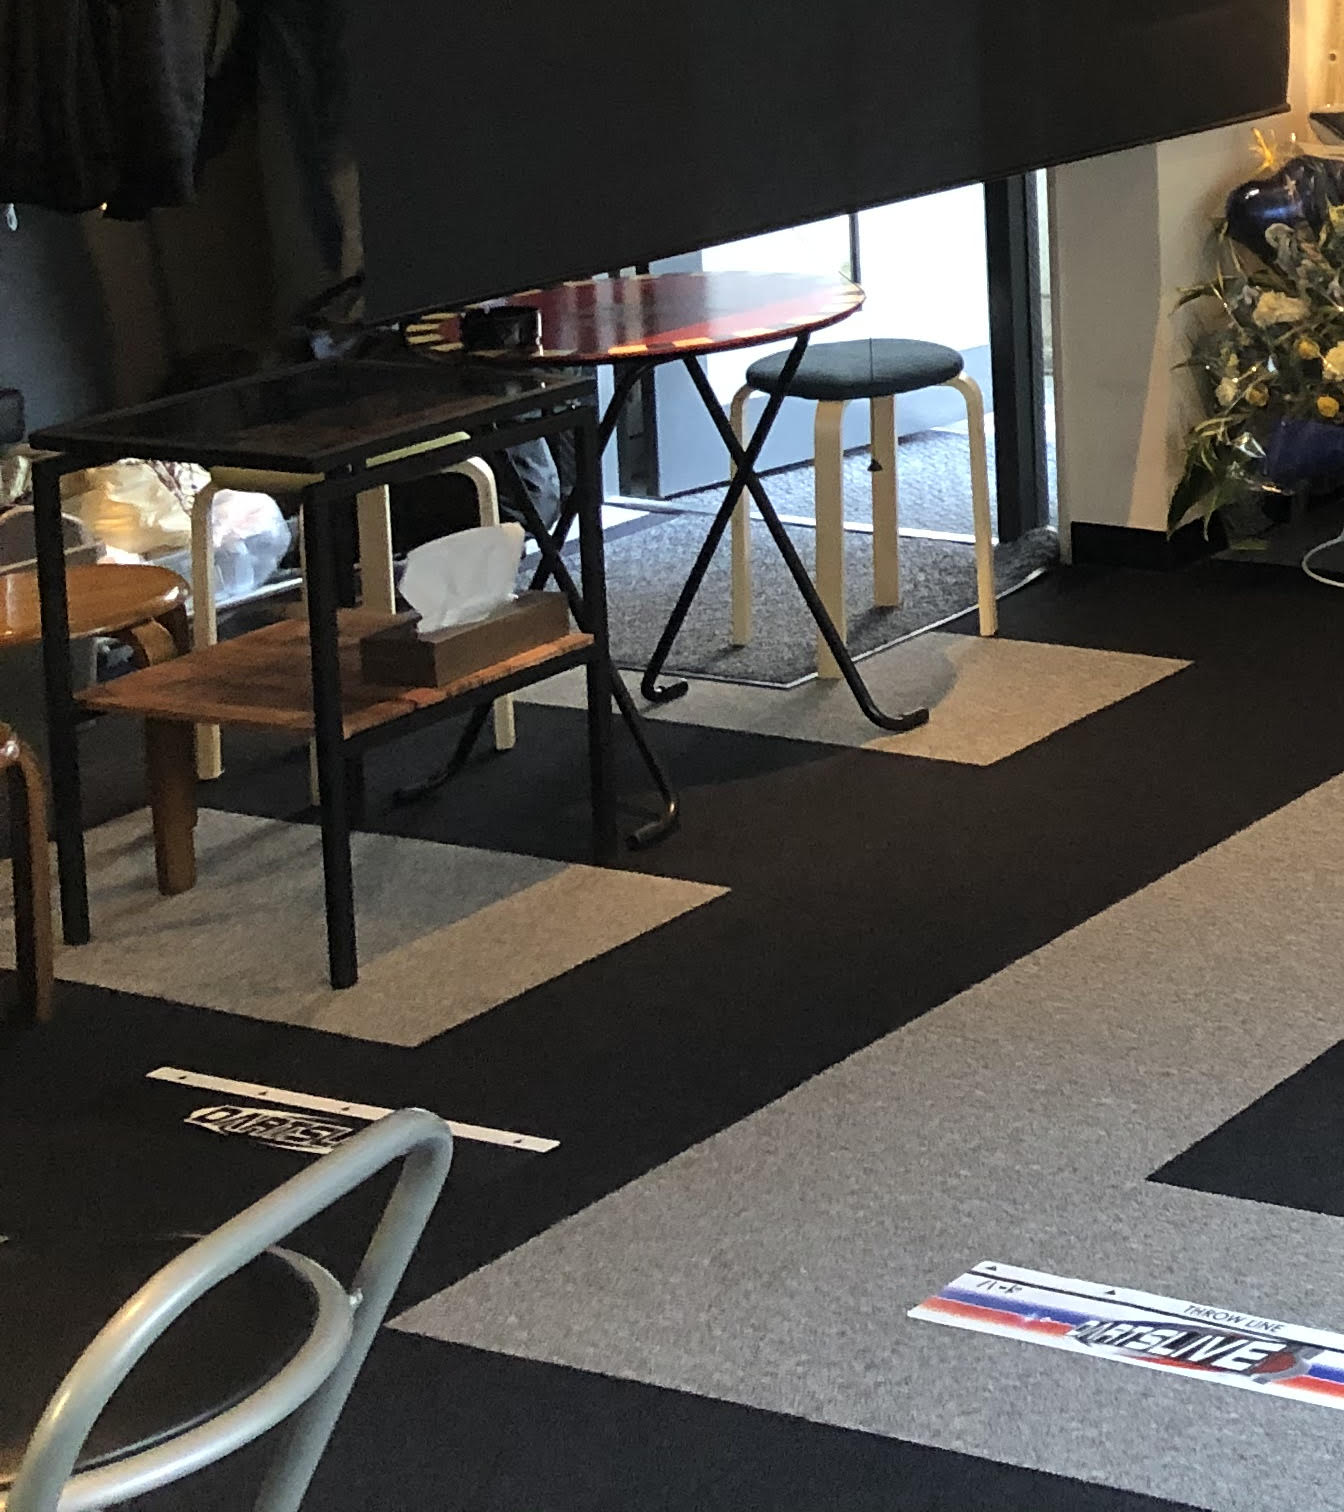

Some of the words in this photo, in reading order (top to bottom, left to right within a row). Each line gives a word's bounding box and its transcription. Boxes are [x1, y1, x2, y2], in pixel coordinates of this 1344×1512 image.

[1183, 1304, 1245, 1326] THROW
[1246, 1318, 1285, 1334] LINE
[1066, 1318, 1288, 1374] DARTSLIVE
